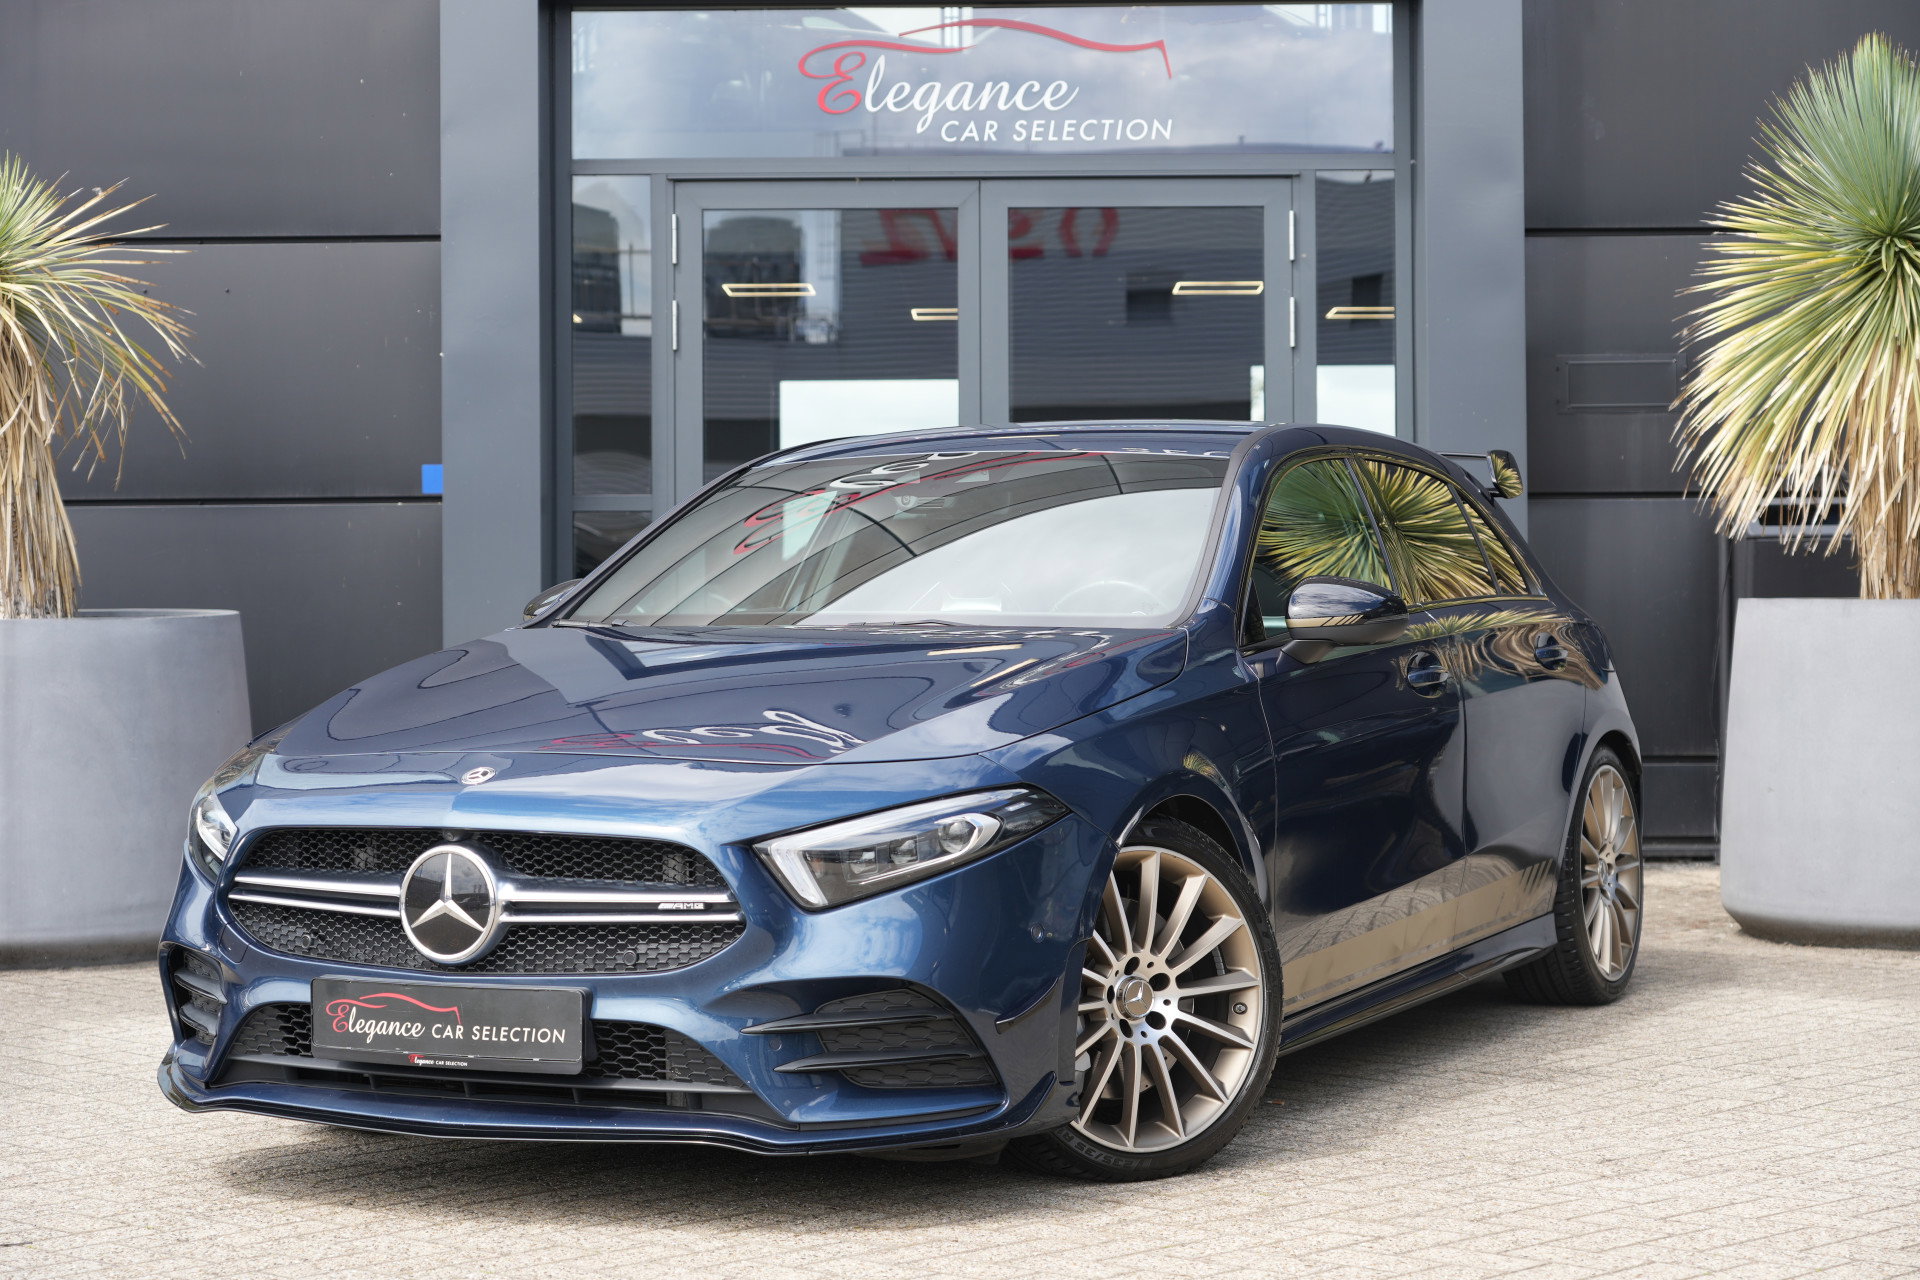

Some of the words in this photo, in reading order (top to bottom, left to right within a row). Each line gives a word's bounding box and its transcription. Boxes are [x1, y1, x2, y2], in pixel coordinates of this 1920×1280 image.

[798, 40, 1079, 134] Elegance
[940, 120, 998, 142] CAR
[1012, 119, 1172, 141] SELECTION
[326, 999, 425, 1043] Elegance
[432, 1023, 463, 1040] CAR
[472, 1026, 565, 1043] SELECTION
